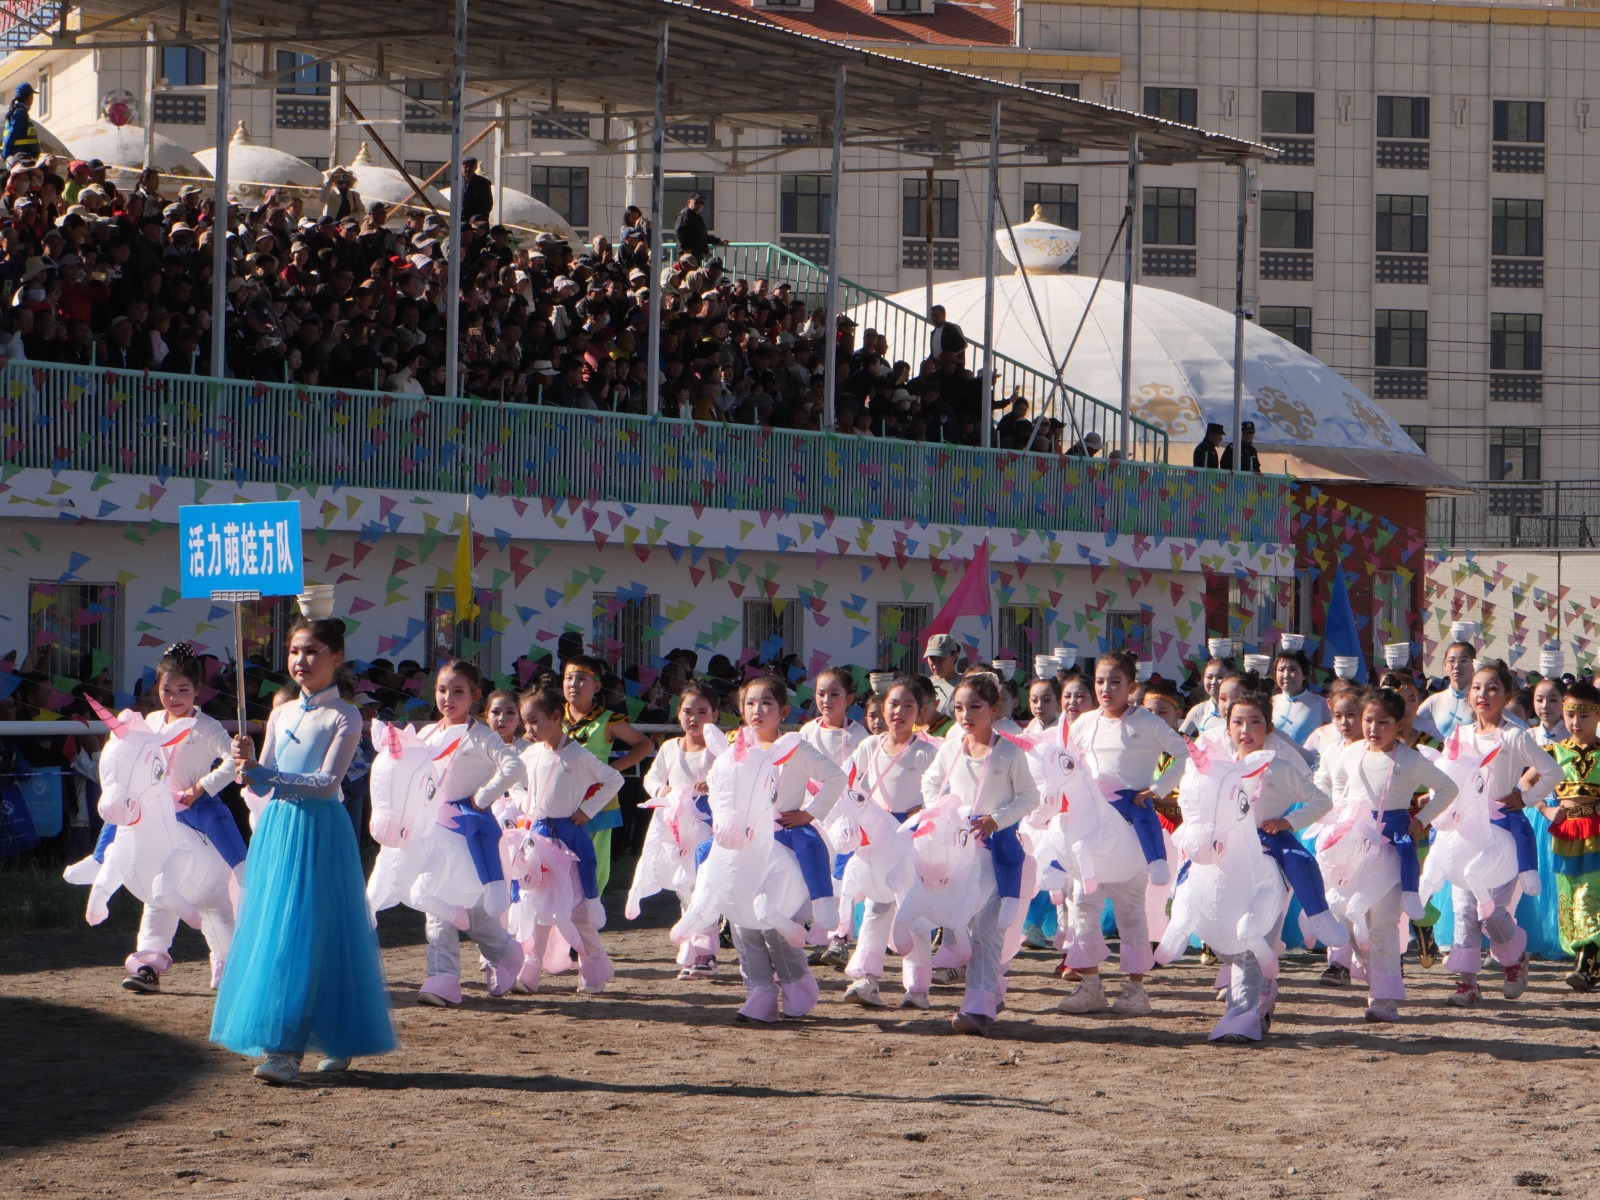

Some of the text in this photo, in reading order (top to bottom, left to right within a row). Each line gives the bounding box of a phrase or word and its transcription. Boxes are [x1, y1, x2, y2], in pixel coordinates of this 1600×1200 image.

[189, 520, 294, 577] 活力萌娃方队
